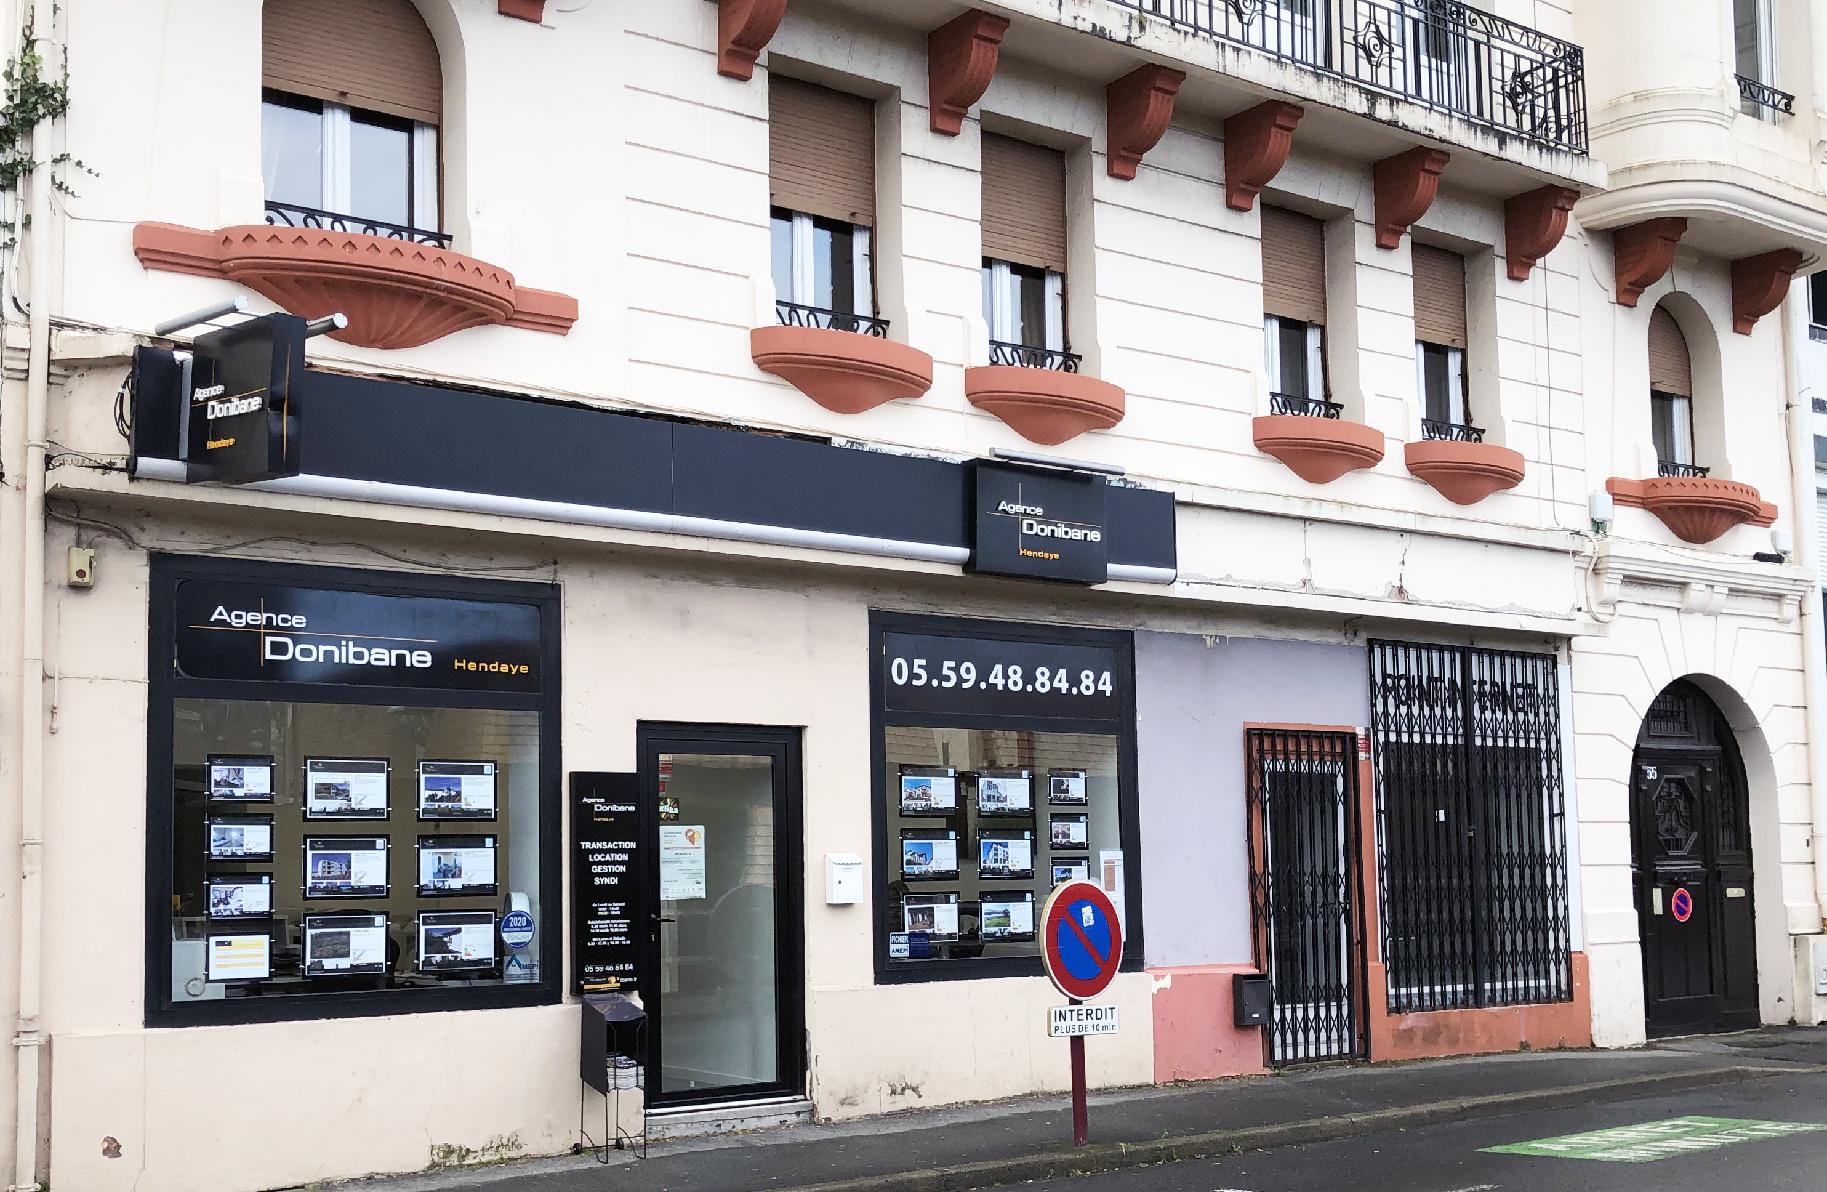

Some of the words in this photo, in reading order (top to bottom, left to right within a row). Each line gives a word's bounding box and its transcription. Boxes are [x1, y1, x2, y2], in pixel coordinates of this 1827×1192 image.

[193, 384, 225, 401] Agence
[207, 396, 263, 420] Donibane
[997, 500, 1044, 516] Agence
[1021, 518, 1101, 542] Donibane
[1019, 548, 1060, 560] Hendaye
[210, 606, 307, 628] Agence
[264, 636, 433, 668] Donibane
[454, 658, 530, 674] Hendaye
[890, 656, 1113, 697] 05.59.48.84.84
[594, 804, 636, 812] Donibane
[580, 841, 636, 850] TRANSACTION
[588, 854, 628, 862] LOCATION
[592, 865, 626, 873] GESTION
[594, 876, 618, 885] SYNDI
[509, 916, 527, 928] 2020
[1054, 1007, 1116, 1022] INTERDIT
[1054, 1024, 1076, 1034] PLUS
[1078, 1024, 1089, 1032] DE
